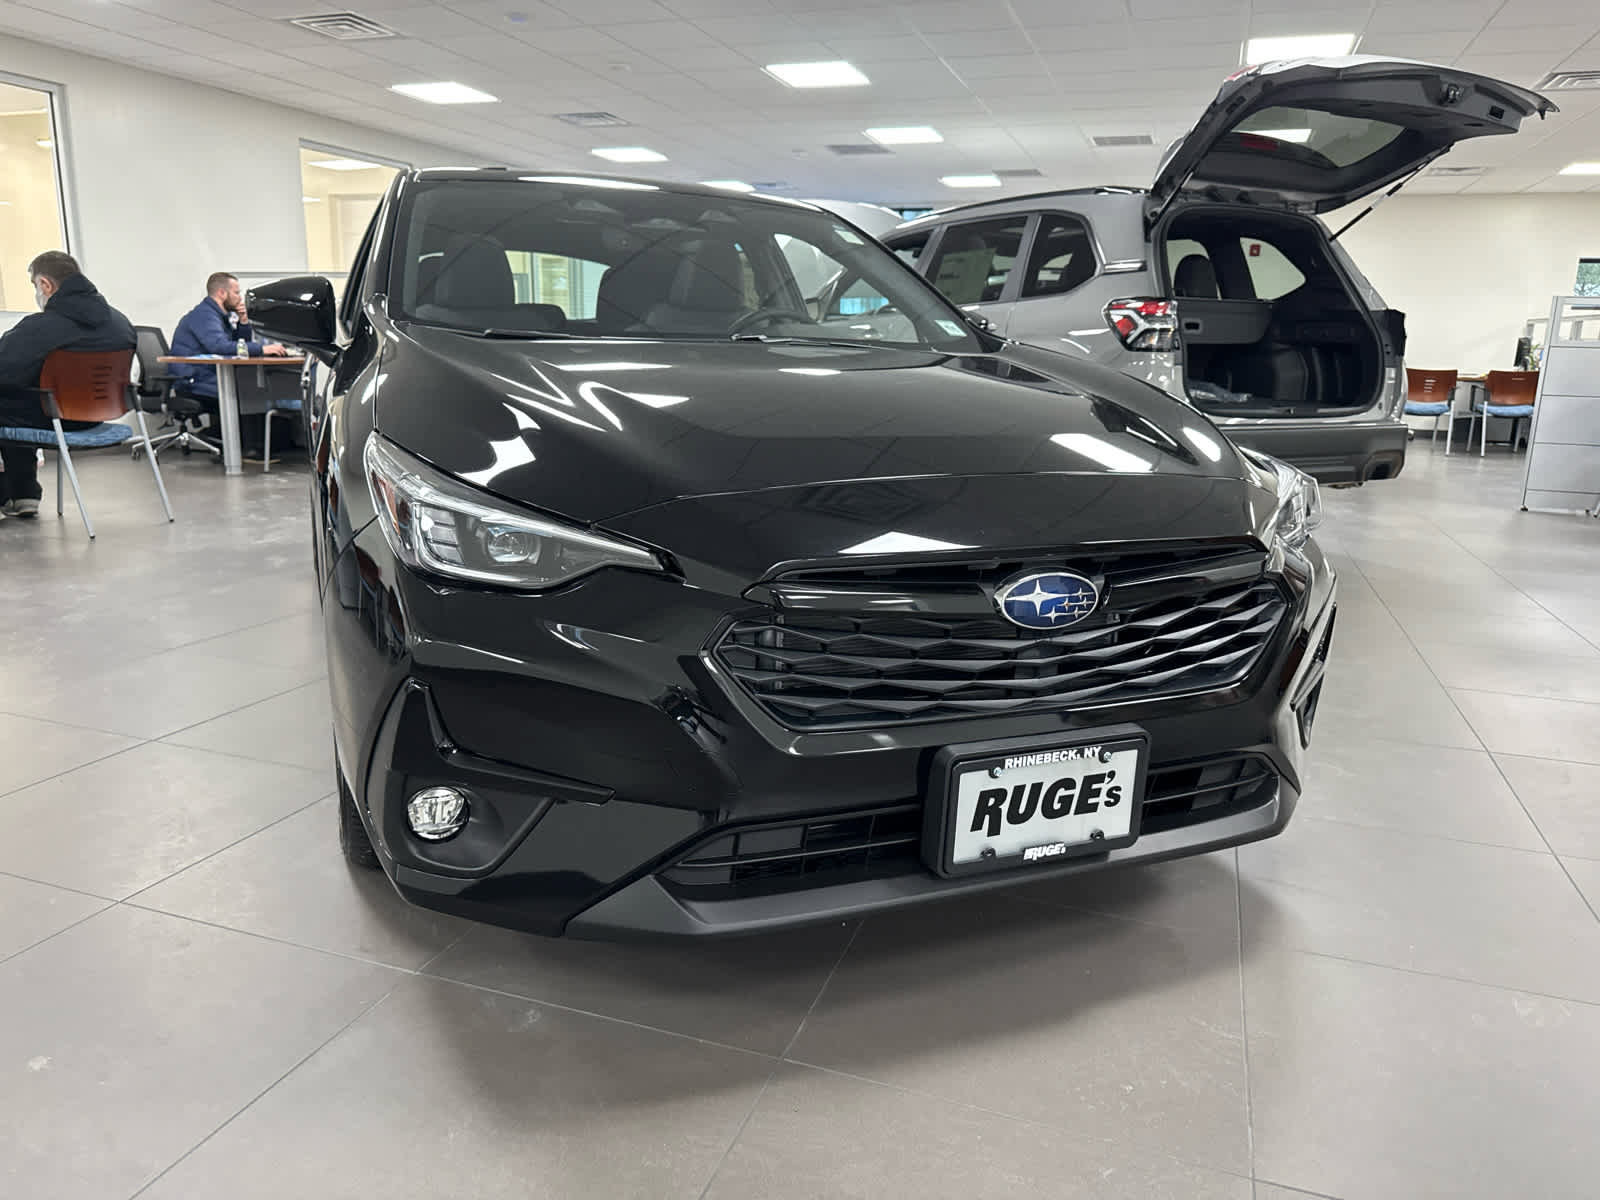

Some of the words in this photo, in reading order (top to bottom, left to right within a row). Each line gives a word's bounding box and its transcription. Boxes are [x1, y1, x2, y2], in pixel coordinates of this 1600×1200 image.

[1004, 749, 1080, 769] RHINEBECK,
[1083, 746, 1102, 759] NY
[969, 770, 1122, 837] RUGE's
